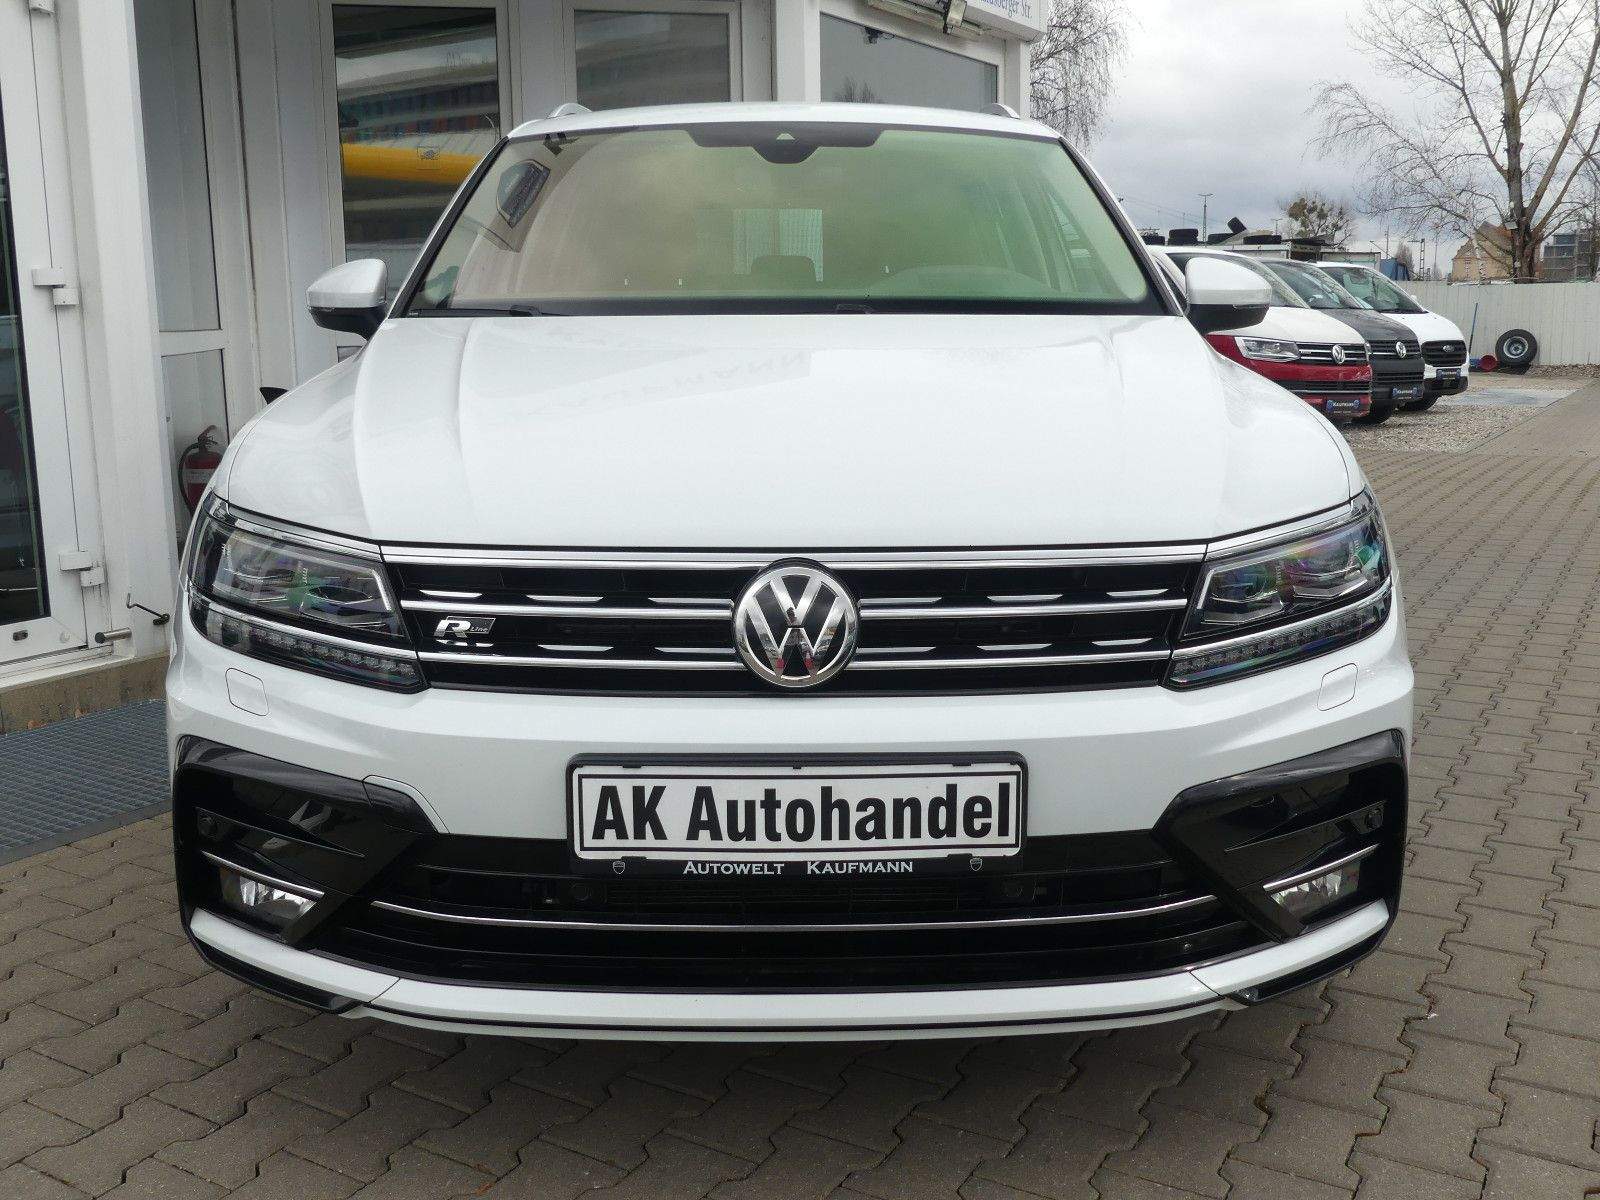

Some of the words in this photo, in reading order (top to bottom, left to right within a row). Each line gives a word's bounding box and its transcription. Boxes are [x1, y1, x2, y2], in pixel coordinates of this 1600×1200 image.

[433, 620, 471, 638] R
[591, 785, 668, 841] AK
[686, 782, 1010, 843] Autohandel
[682, 860, 785, 876] AUTOWELT
[806, 860, 914, 875] KAUFMANN
